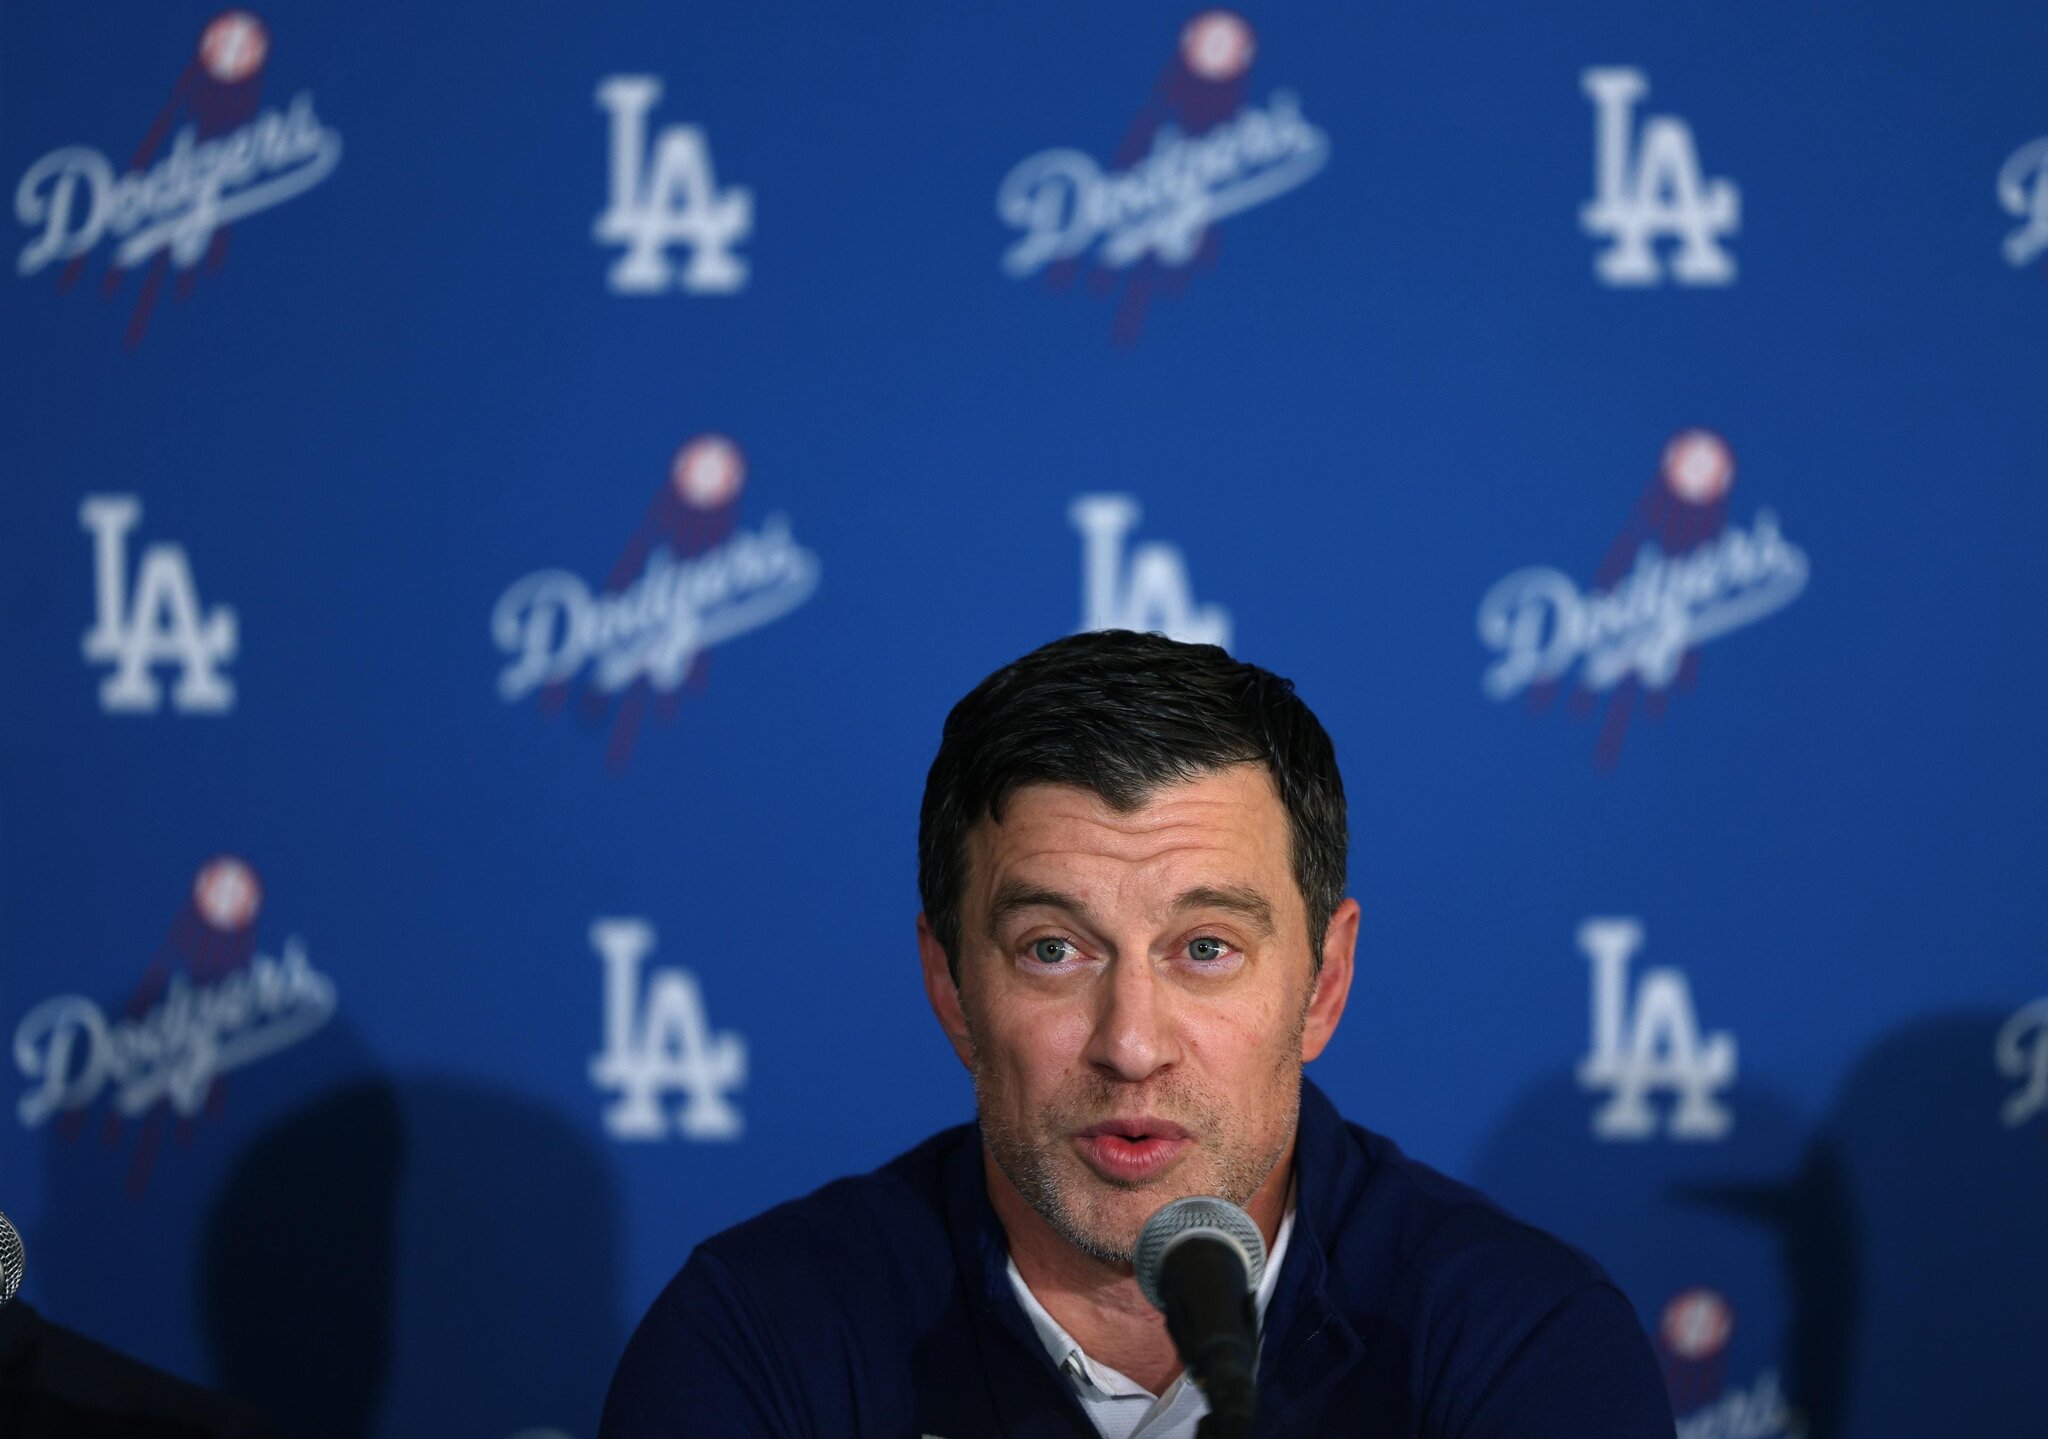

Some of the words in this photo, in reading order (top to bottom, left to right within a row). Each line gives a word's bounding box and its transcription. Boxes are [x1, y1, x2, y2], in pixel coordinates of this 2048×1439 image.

[595, 75, 753, 294] LA
[1581, 67, 1740, 287] LA
[81, 495, 238, 713] LA
[590, 919, 746, 1139] LA
[1577, 918, 1736, 1139] LA
